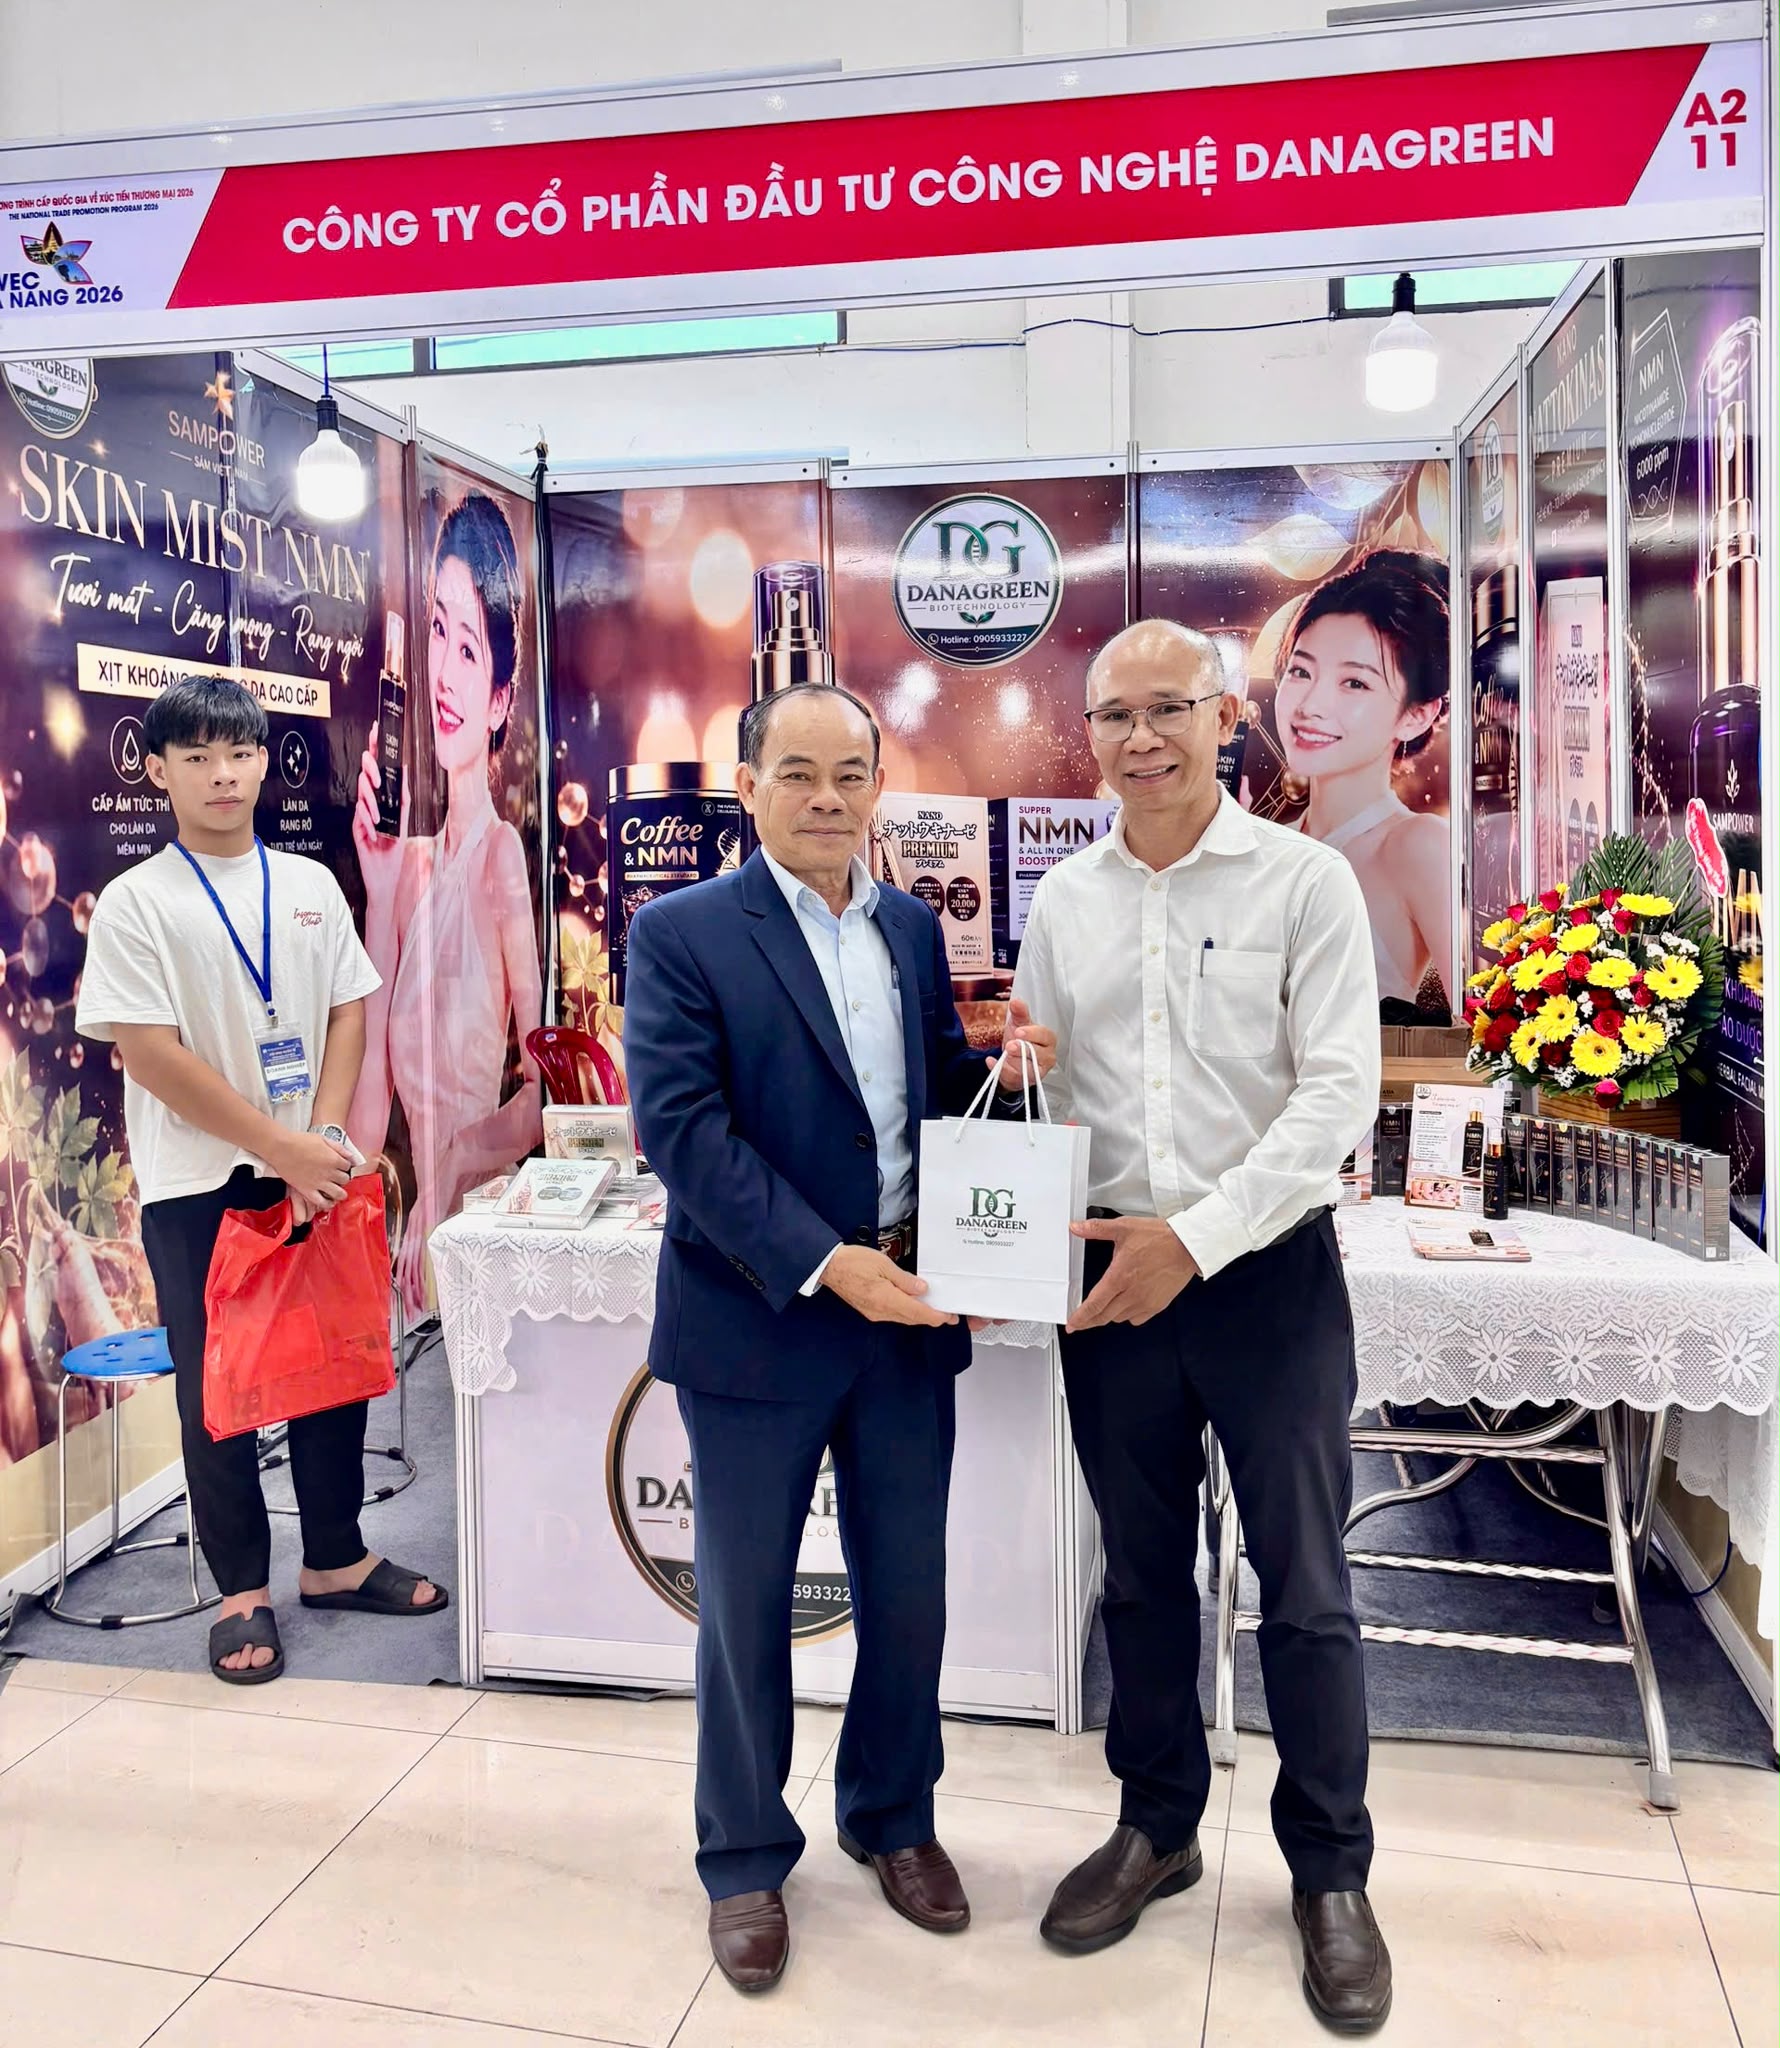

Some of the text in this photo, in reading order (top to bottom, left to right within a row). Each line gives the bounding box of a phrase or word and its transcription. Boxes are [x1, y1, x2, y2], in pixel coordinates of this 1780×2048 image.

[1683, 88, 1748, 128] A2
[1688, 132, 1741, 170] 11
[177, 188, 194, 198] 2026
[282, 116, 1555, 254] CÔNG TY CỔ PHẦN ĐẦU TƯ CÔNG NGHỆ DANAGREEN
[21, 211, 50, 219] NATIONAL
[52, 209, 71, 217] TRADE
[72, 206, 109, 216] PROMOTION
[111, 204, 142, 213] PROGRAM
[76, 286, 123, 304] 2026
[1640, 349, 1664, 394] NMN
[169, 410, 265, 468] SAMPOWER
[1636, 454, 1653, 480] 6000
[20, 444, 368, 605] SKIN MIST NMN
[932, 520, 1026, 582] DG
[907, 580, 1051, 602] DANAGREEN
[172, 580, 225, 654] Căng
[929, 602, 1027, 612] BIOTECHNOLOGY
[940, 634, 1027, 644] Hotline: 0905933227
[98, 660, 122, 687] XỊT
[251, 681, 266, 700] DA
[270, 684, 292, 702] CAO
[296, 680, 318, 707] CẤP
[92, 792, 113, 811] CẤP
[298, 800, 309, 812] DA
[1019, 806, 1051, 814] SUPPER
[918, 811, 943, 820] NANO
[1712, 812, 1754, 834] SAMPOWER
[109, 823, 128, 835] CHO
[145, 823, 156, 834] DA
[620, 815, 703, 845] Coffee
[883, 820, 977, 840] ナットウキナーゼ
[1019, 817, 1094, 844] NMN
[624, 846, 697, 866] & NMN
[902, 840, 958, 858] PREMIUM
[1057, 847, 1074, 855] ONE
[1738, 1072, 1758, 1096] FACIAL
[969, 1187, 1016, 1219] DG
[956, 1217, 1027, 1230] DANAGREEN
[792, 1584, 851, 1602] 593322
